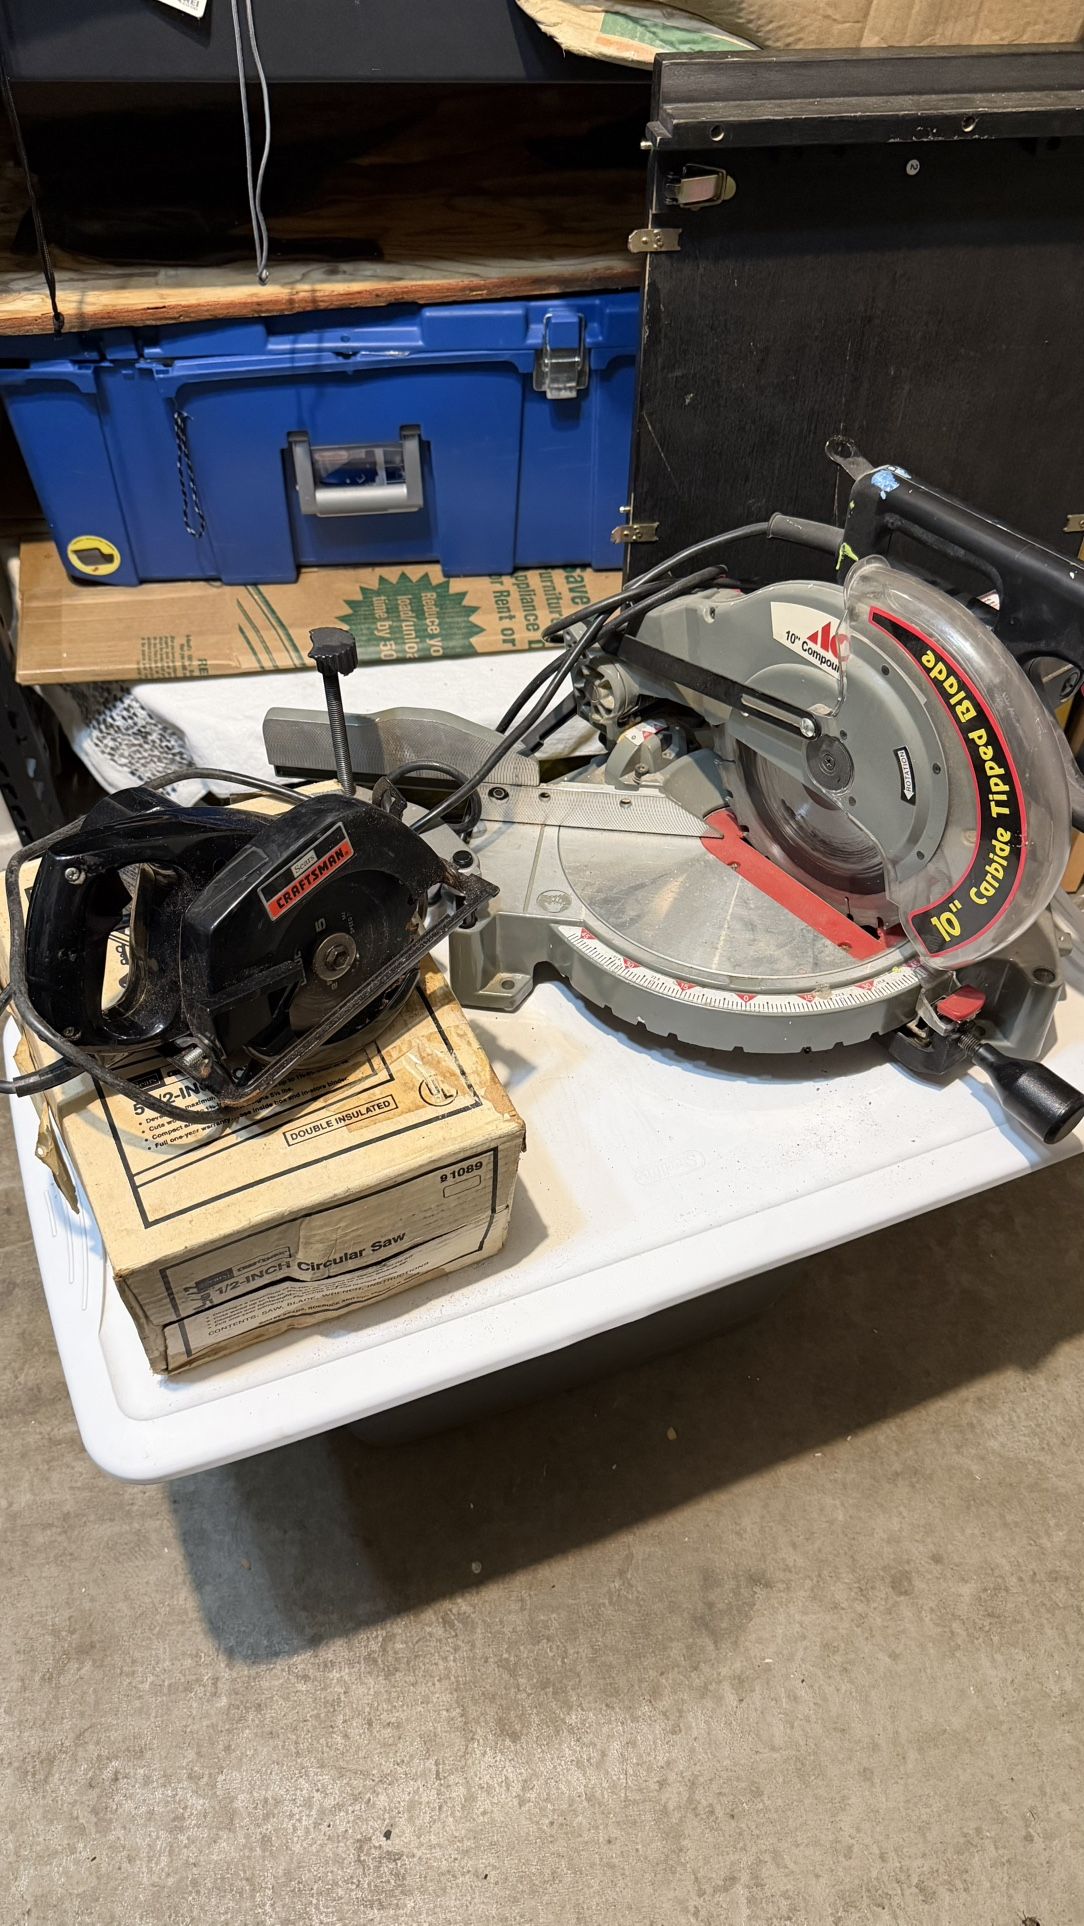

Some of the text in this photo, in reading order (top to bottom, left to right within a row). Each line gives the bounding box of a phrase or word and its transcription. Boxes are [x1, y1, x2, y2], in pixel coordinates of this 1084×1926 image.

[373, 595, 388, 625] time
[493, 590, 516, 622] Rent
[511, 572, 542, 632] ppliance
[539, 568, 564, 622] urnitur
[374, 622, 392, 638] by
[397, 594, 419, 659] load/unloa
[421, 591, 444, 657] Reduce yo
[500, 628, 517, 647] or
[900, 750, 914, 792] ROTATION
[921, 649, 1012, 942] 10" Carbide Tipped Blade
[276, 847, 345, 910] CRAFTSMAN
[293, 854, 316, 874] Sears
[151, 1123, 184, 1140] Compact
[154, 1139, 169, 1149] Full
[169, 1128, 200, 1143] one-year
[290, 1100, 391, 1141] DOUBLE INSULATED
[440, 1161, 483, 1183] 91089
[297, 1247, 367, 1273] Circular
[370, 1231, 407, 1253] Saw
